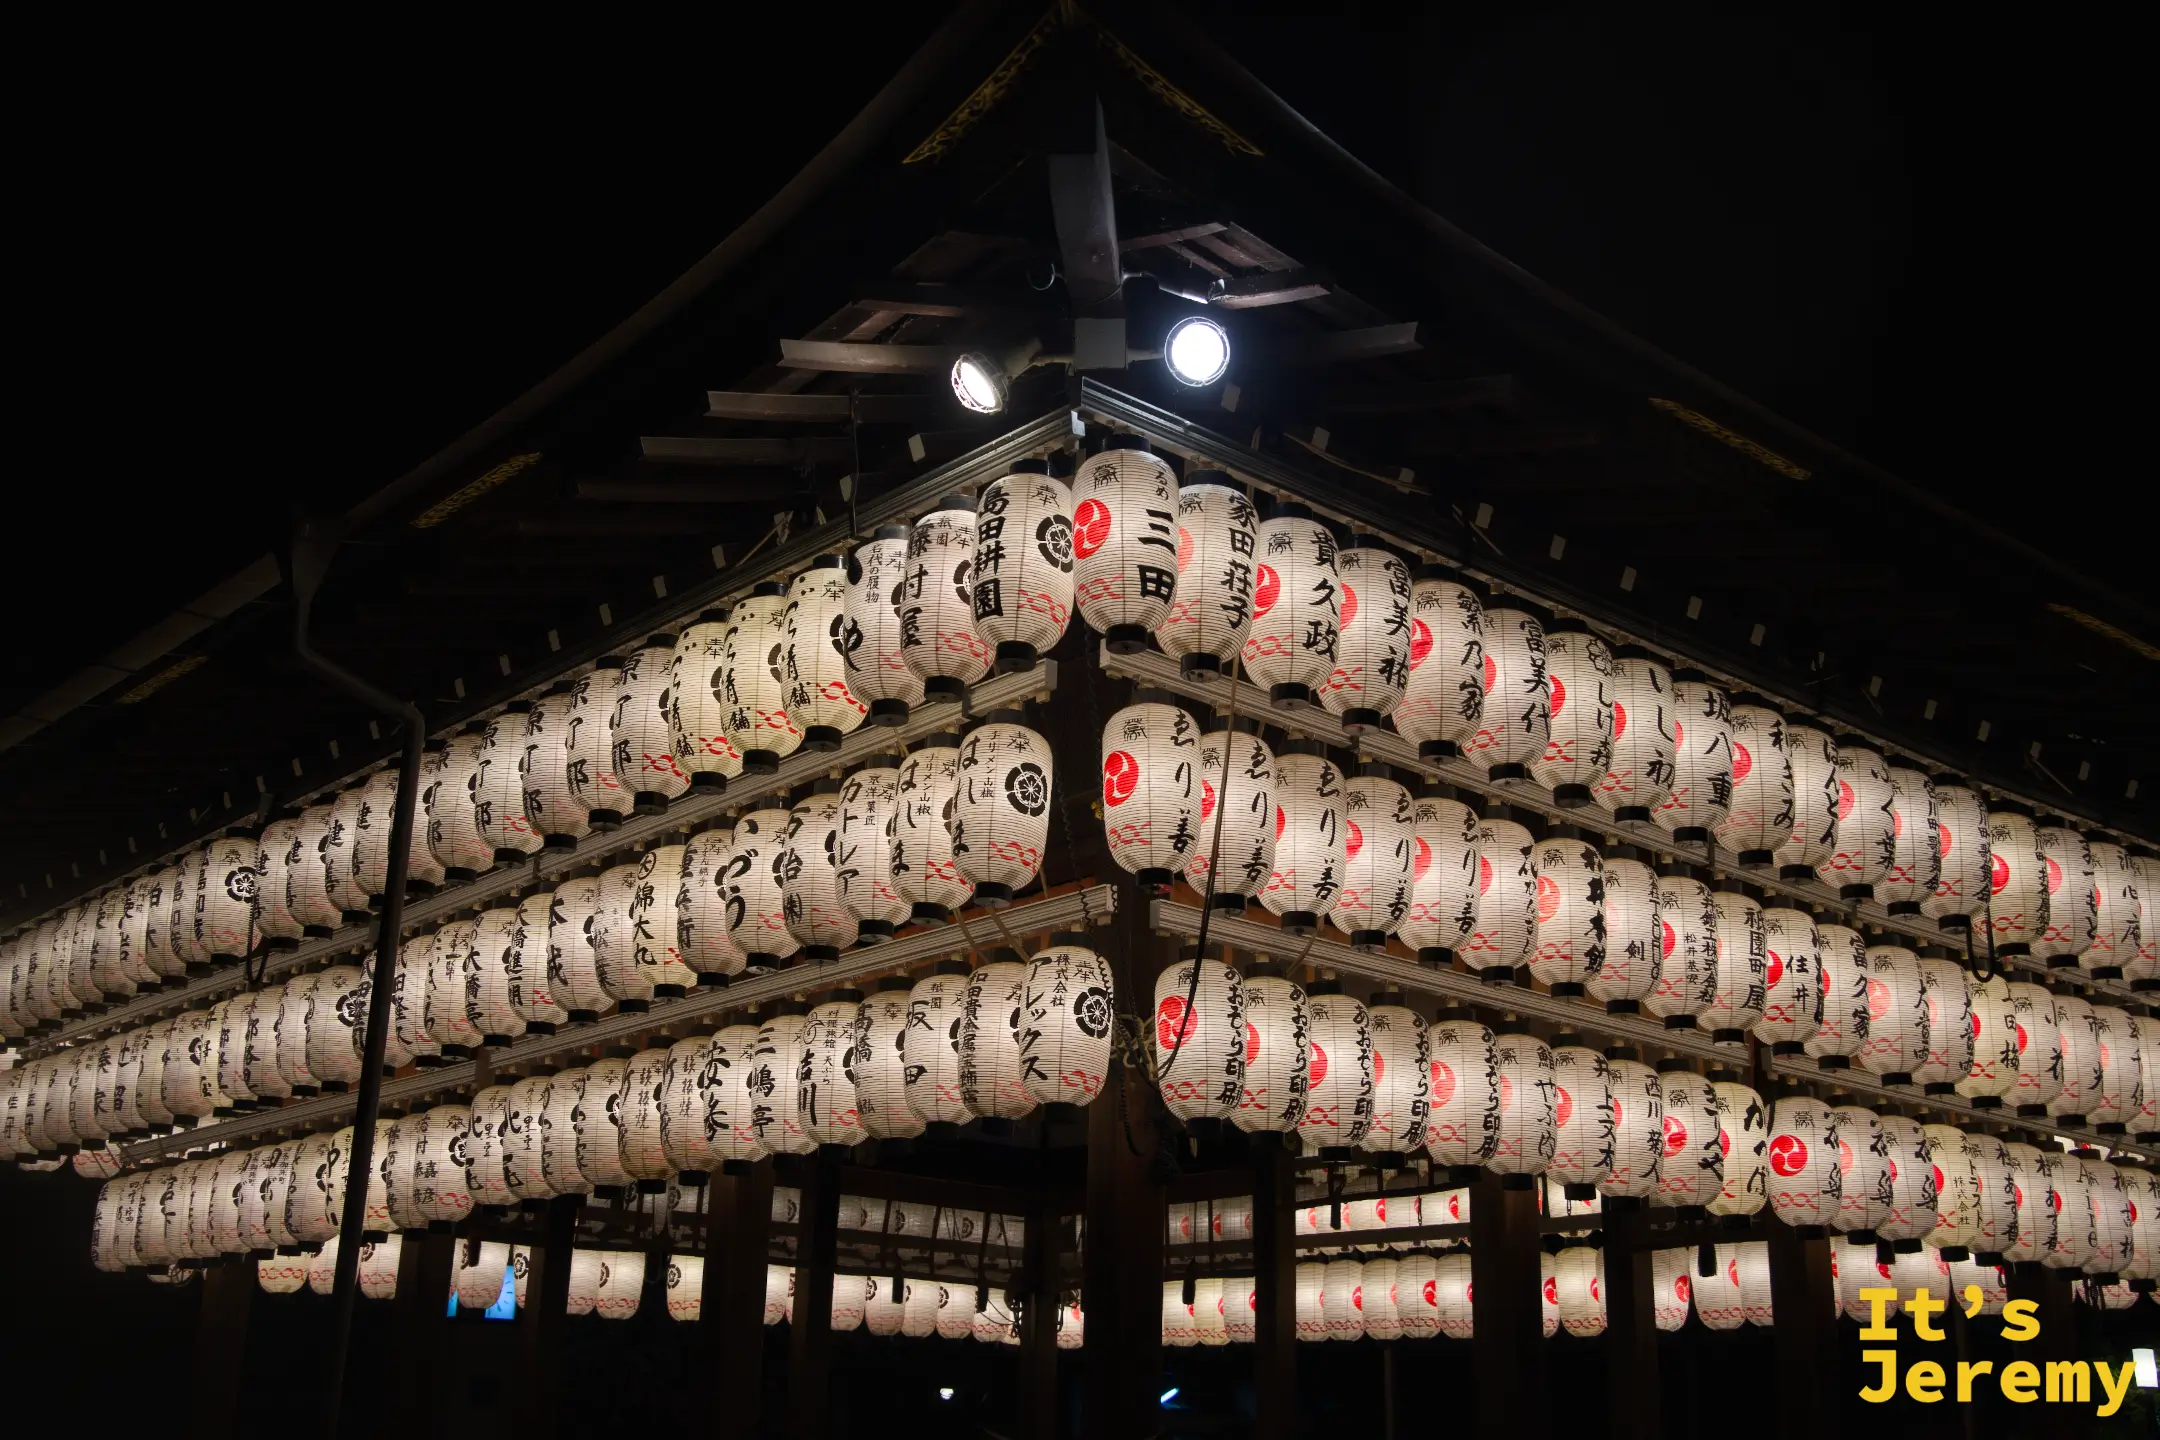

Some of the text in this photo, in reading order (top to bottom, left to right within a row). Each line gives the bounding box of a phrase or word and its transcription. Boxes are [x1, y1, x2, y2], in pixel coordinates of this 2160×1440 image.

[971, 484, 1010, 622] 島田耕園
[836, 782, 863, 897] カトレア
[1020, 957, 1052, 1082] アレックス
[1050, 954, 1071, 1007] 株式会社
[751, 1027, 776, 1138] 三嶋亭
